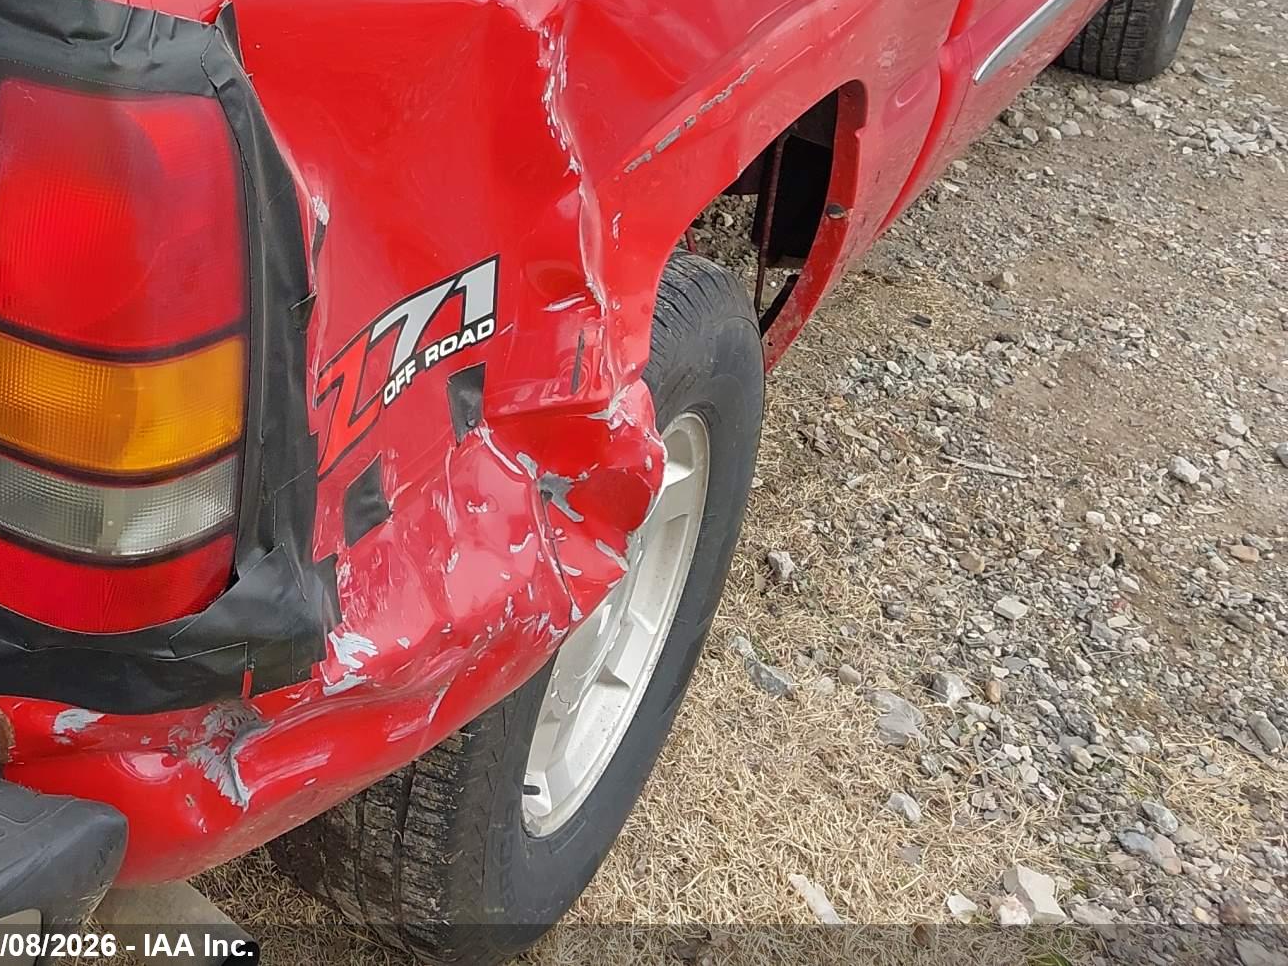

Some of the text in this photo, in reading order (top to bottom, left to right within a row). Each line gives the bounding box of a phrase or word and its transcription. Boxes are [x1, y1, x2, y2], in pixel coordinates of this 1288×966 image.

[315, 254, 500, 479] Z71
[383, 318, 496, 407] OFF ROAD
